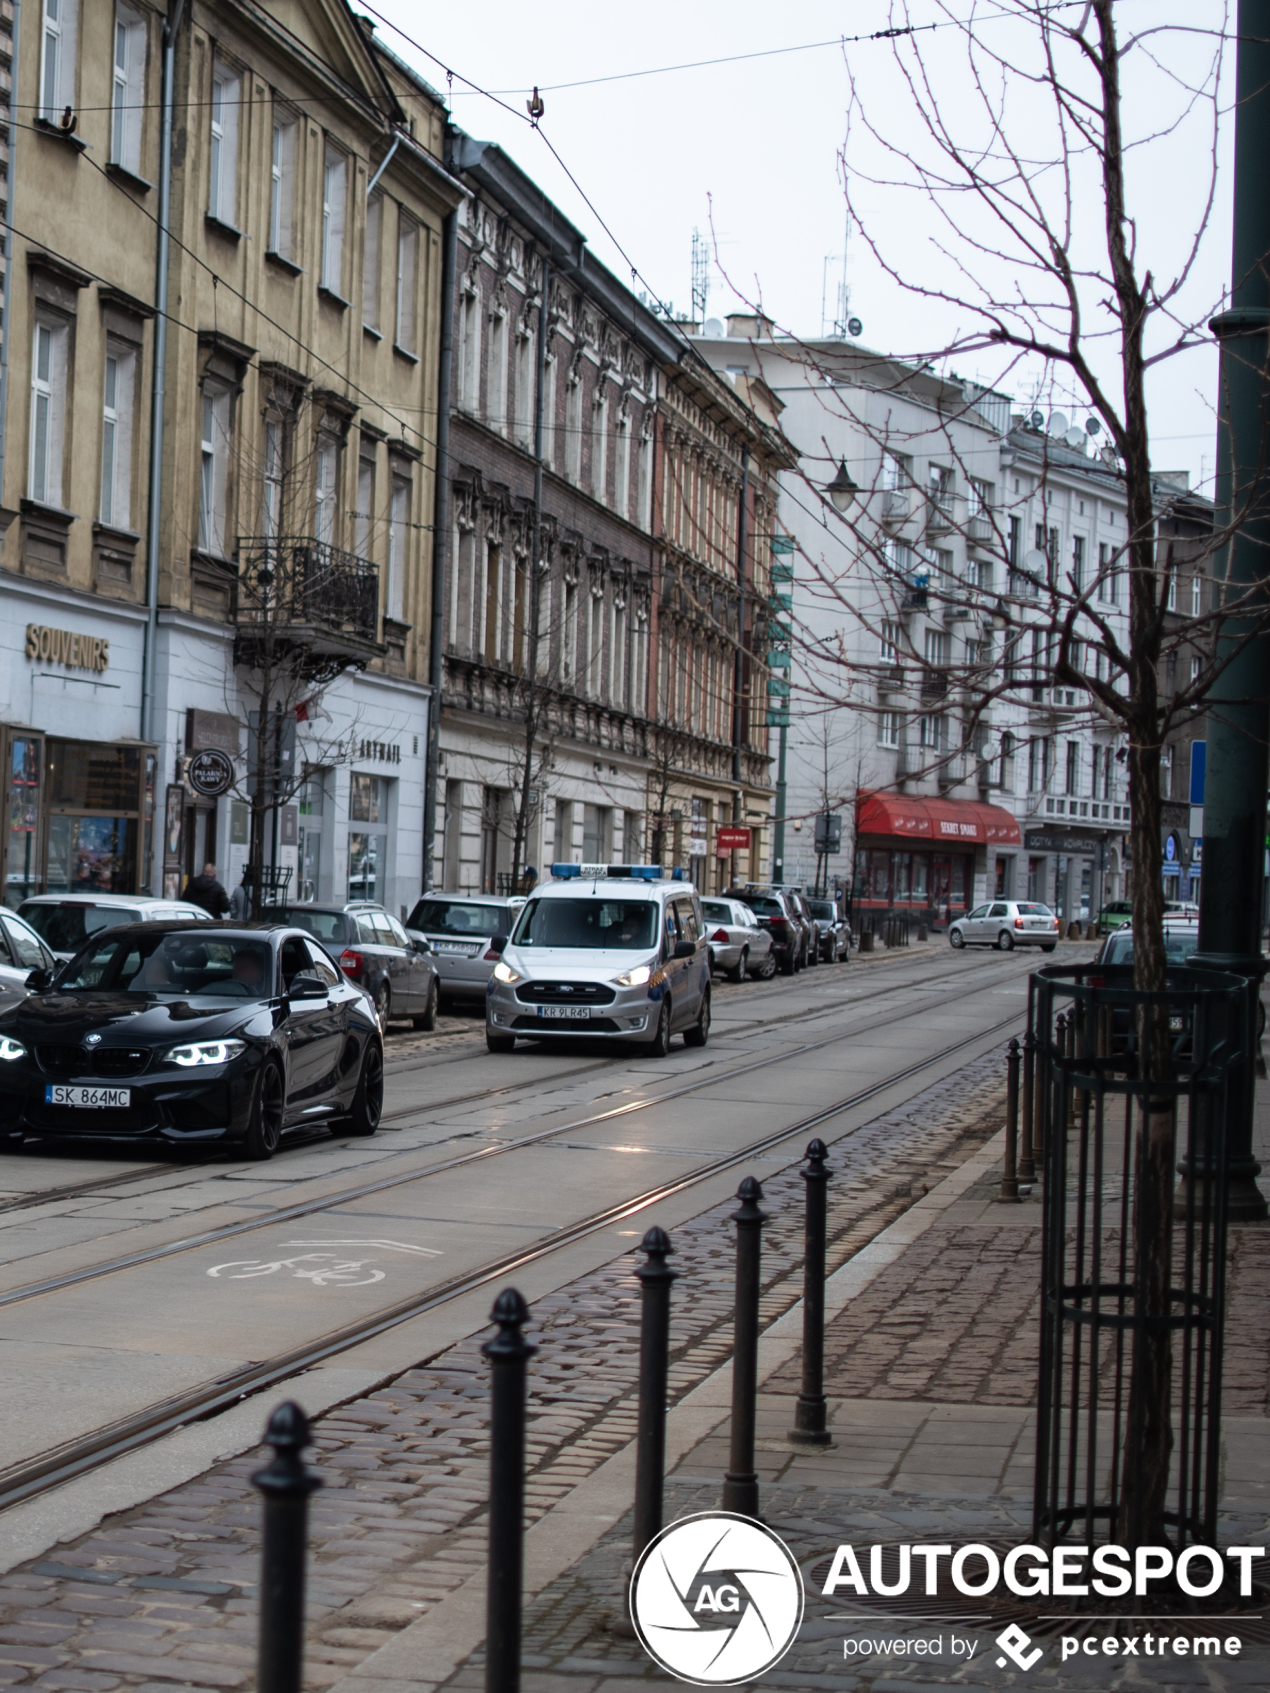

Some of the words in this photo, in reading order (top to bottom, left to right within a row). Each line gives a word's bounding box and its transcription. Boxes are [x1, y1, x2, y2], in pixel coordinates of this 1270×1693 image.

[25, 623, 109, 671] SOUVENIRS
[200, 775, 221, 783] KAWY
[940, 821, 959, 835] SEKRET
[959, 823, 978, 837] SMAKU
[544, 1008, 557, 1017] KR
[559, 1008, 588, 1018] 9LR45
[55, 1087, 75, 1103] SK
[81, 1089, 127, 1106] 864MC
